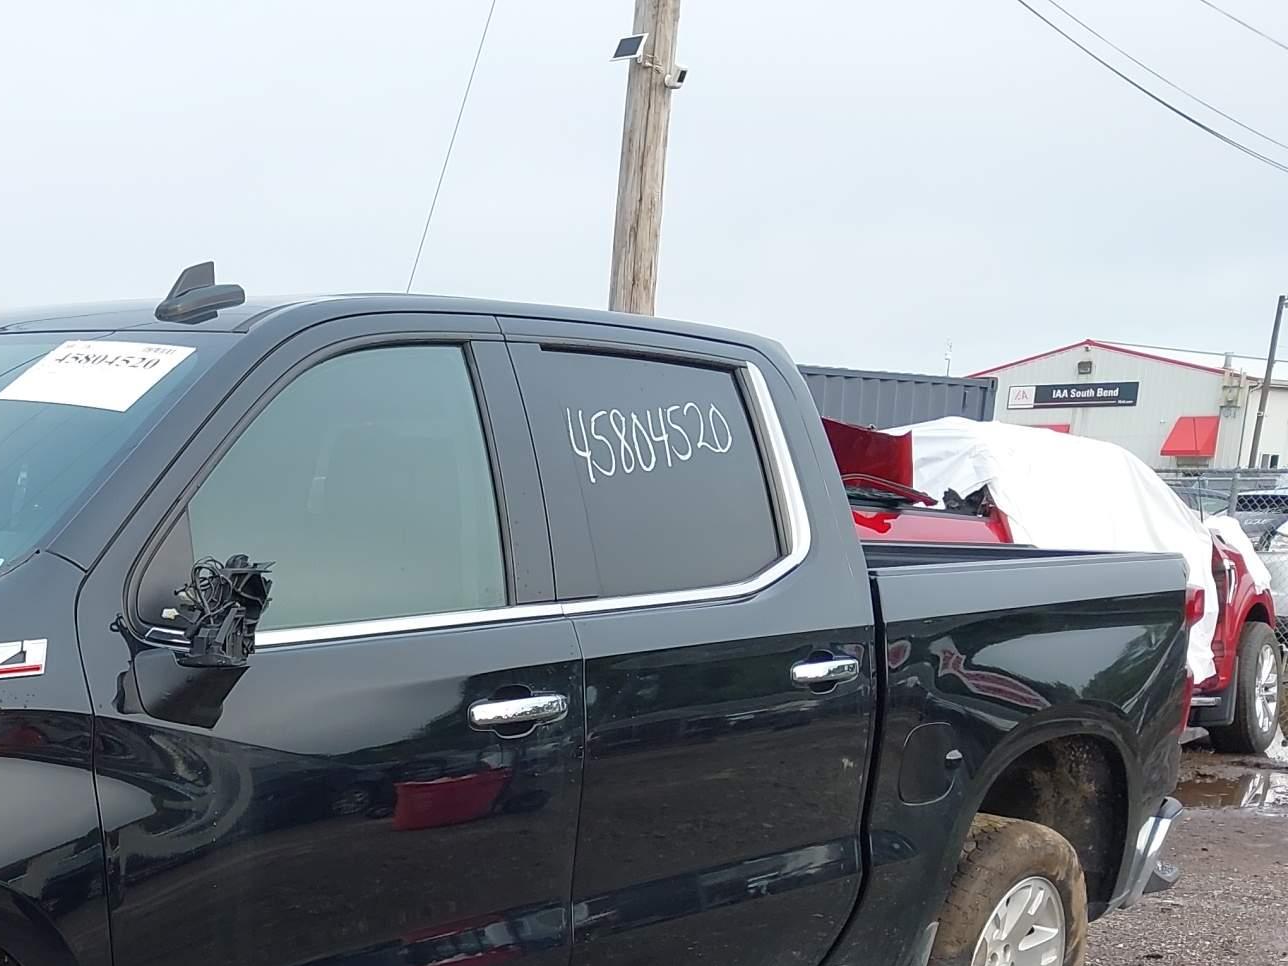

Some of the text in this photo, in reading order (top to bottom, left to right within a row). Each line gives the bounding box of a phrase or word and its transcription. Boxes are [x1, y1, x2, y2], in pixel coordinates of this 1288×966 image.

[54, 352, 161, 370] 45804520
[1052, 387, 1120, 399] IAA South Bend
[566, 402, 733, 483] 45804520
